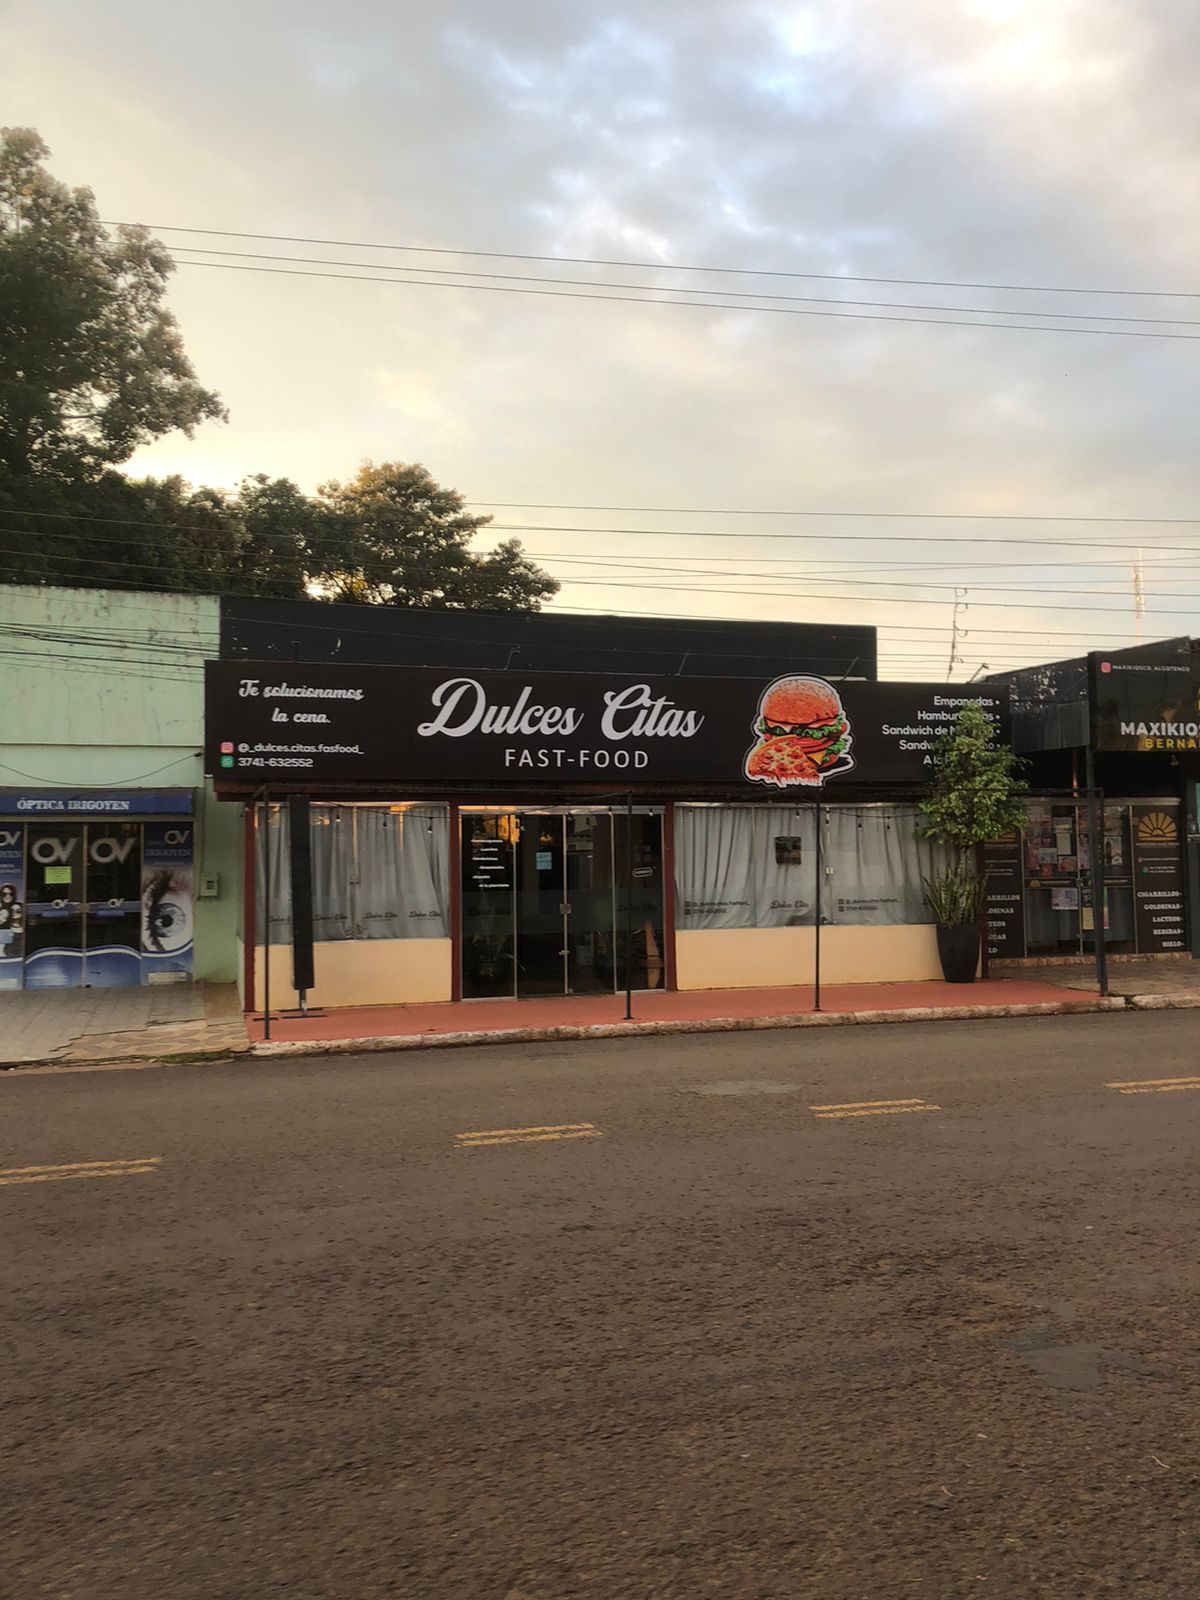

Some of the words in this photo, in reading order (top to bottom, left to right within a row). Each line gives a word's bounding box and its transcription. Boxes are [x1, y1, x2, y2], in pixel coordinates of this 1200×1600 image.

[239, 679, 260, 698] Te
[263, 682, 364, 701] solucionamos
[272, 707, 289, 722] la
[293, 712, 331, 723] cena.
[417, 677, 584, 737] Dulces
[602, 683, 705, 740] Citas
[917, 711, 994, 721] Hamburas
[882, 724, 933, 736] Sandwich
[934, 725, 948, 735] de
[1120, 721, 1200, 736] MAXIKIO
[1145, 738, 1200, 749] BERNA
[238, 757, 314, 767] 3741-632552
[504, 749, 649, 768] FAST-FOOD
[67, 800, 130, 810] IRIGOYEN
